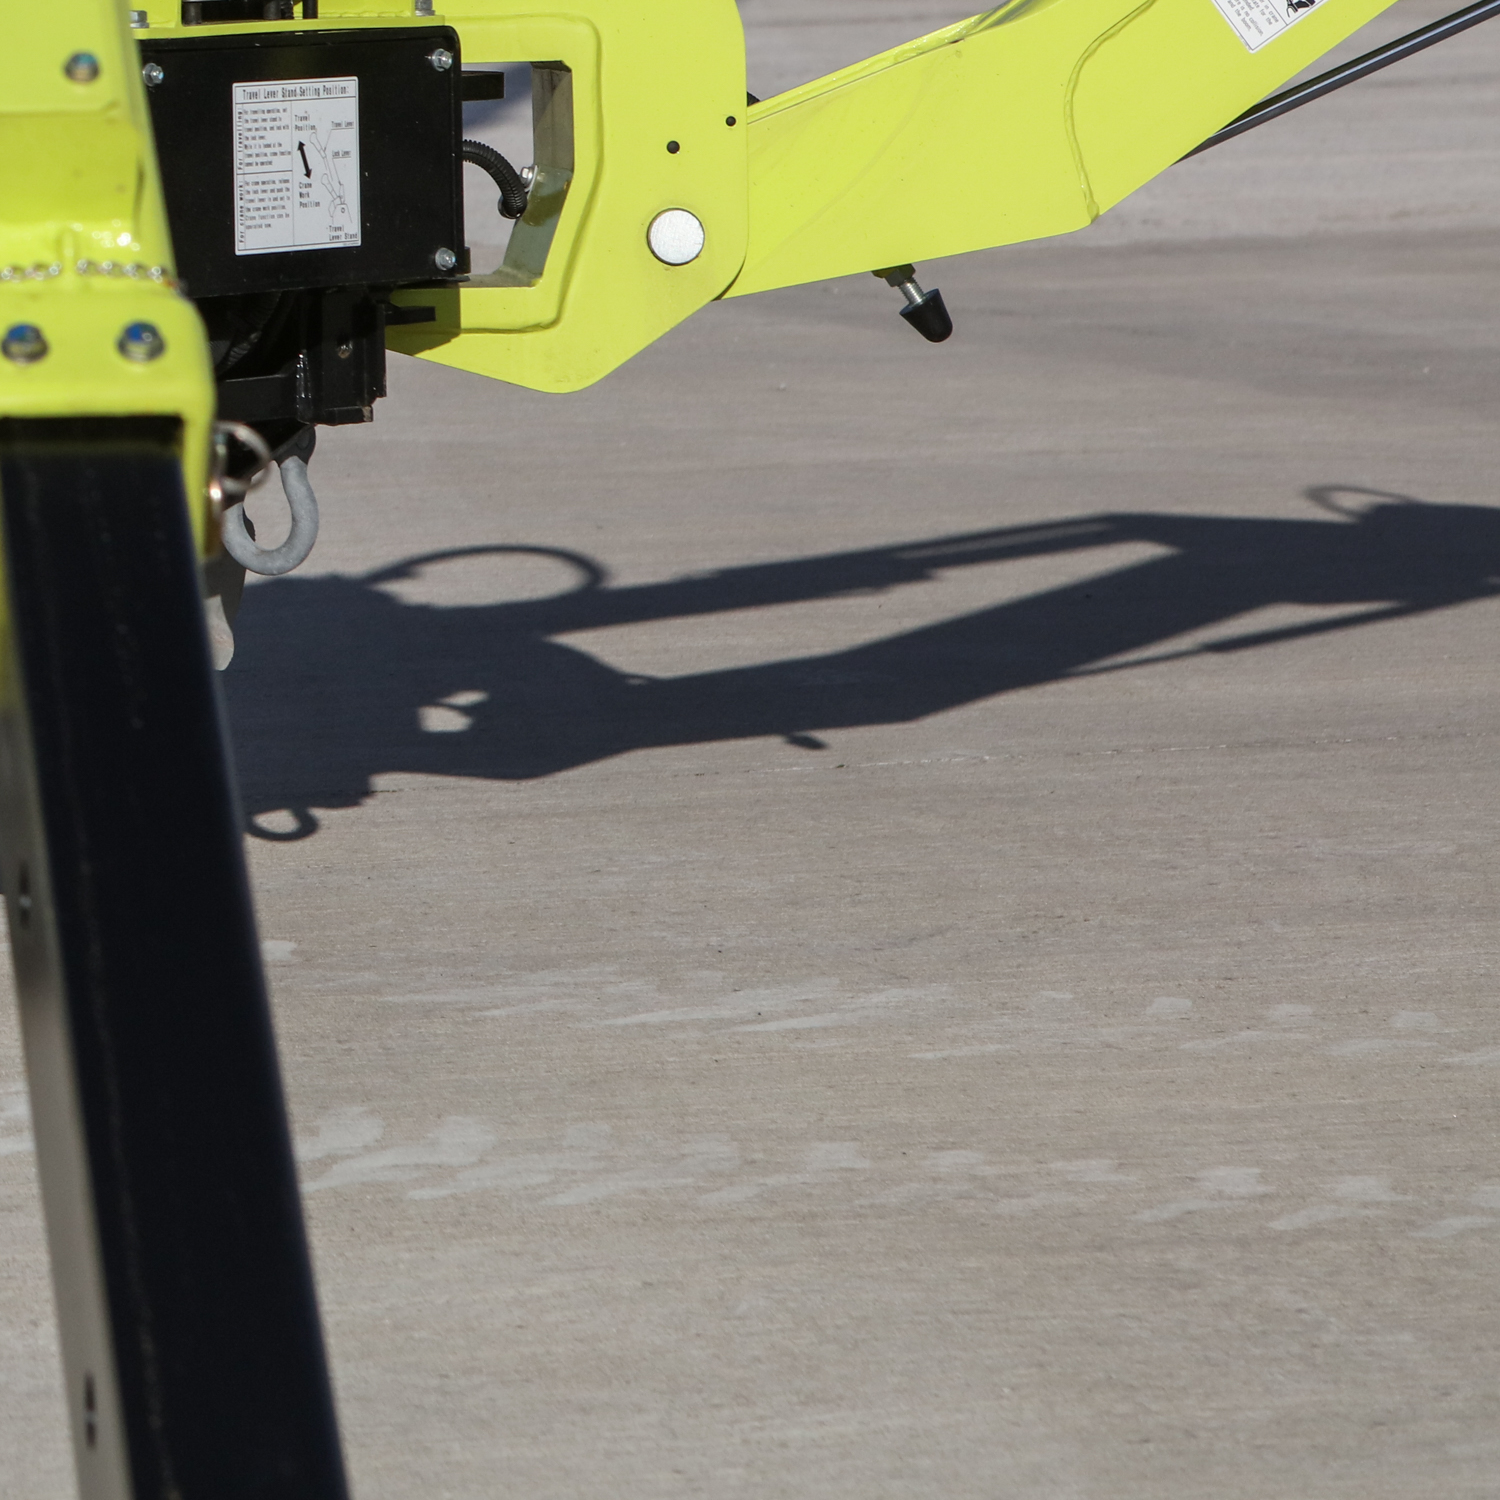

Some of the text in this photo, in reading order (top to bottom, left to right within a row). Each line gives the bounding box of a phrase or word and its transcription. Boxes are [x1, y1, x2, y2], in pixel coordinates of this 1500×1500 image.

[1227, 0, 1236, 8] and
[1269, 11, 1279, 23] crane
[242, 88, 260, 100] Travel
[263, 87, 279, 99] Lever
[281, 86, 297, 98] Stand
[298, 84, 320, 98] Setting
[294, 113, 310, 122] Travel
